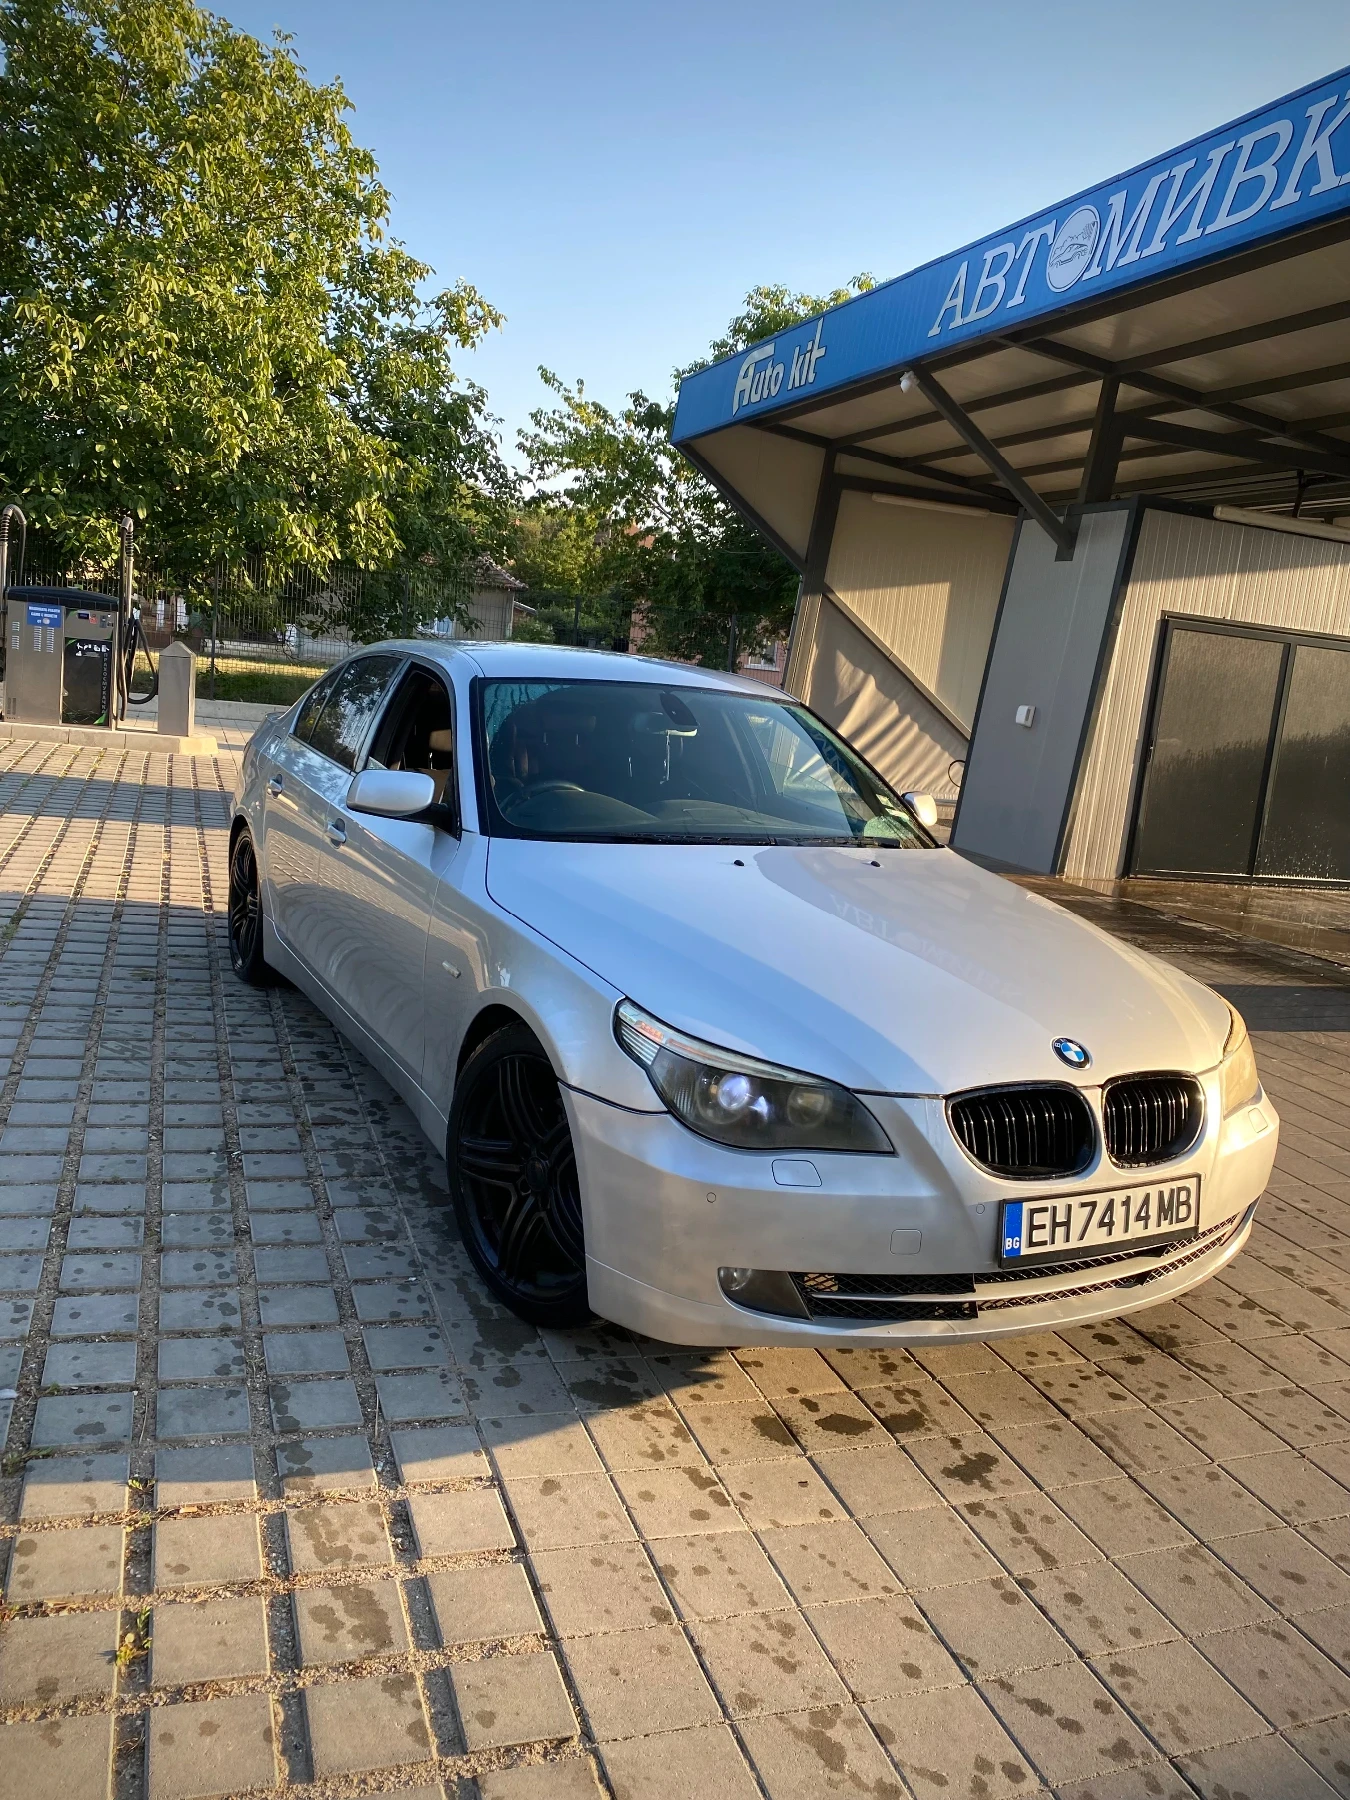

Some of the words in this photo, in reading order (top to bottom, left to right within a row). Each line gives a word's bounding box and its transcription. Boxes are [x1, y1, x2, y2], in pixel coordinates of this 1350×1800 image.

[928, 88, 1350, 338] АВТОМИВК
[733, 343, 785, 416] Auto
[787, 317, 826, 391] kit
[1005, 1236, 1020, 1251] BG
